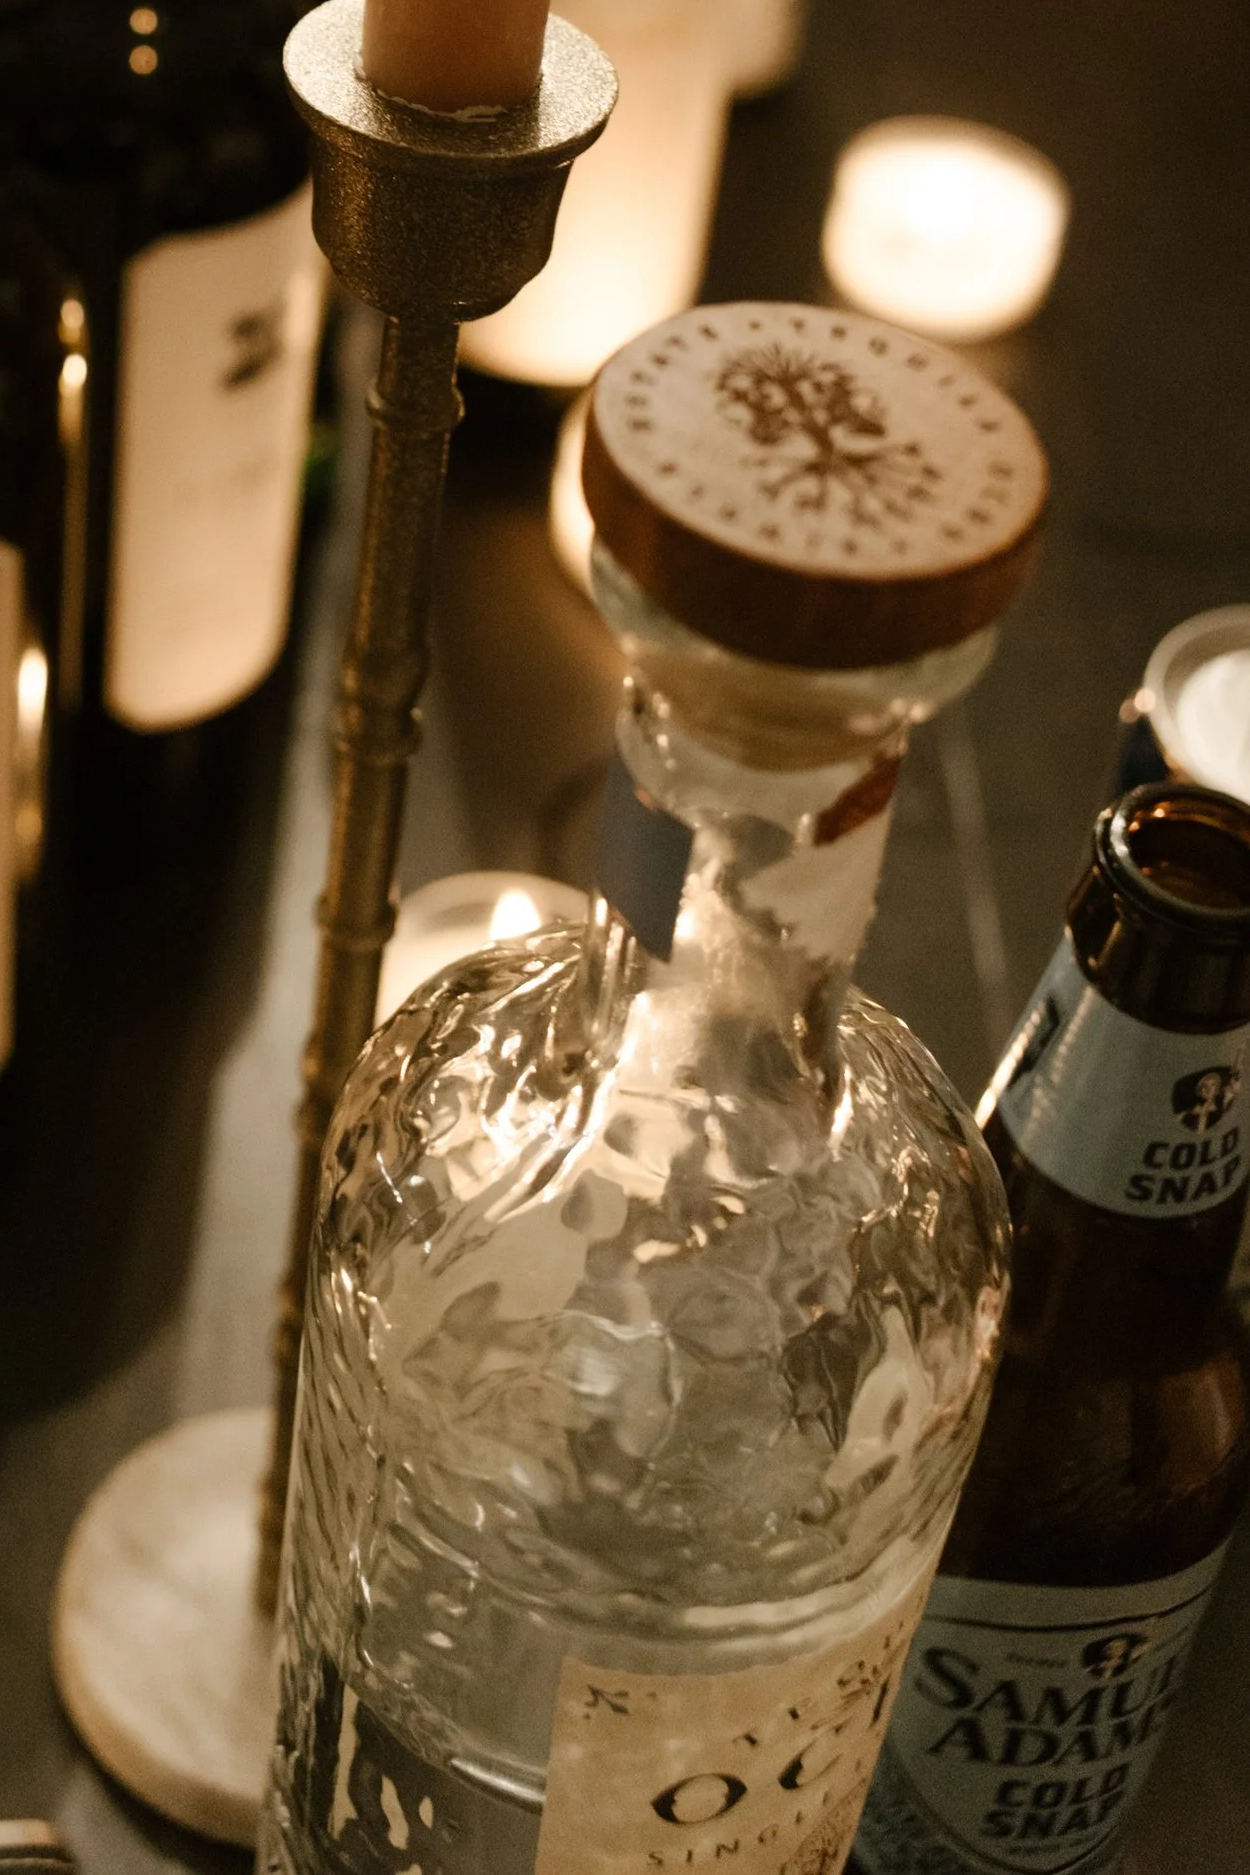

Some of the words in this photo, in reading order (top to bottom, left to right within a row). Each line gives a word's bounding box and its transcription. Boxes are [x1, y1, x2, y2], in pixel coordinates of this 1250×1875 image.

[1143, 1126, 1239, 1170] COLD
[1124, 1154, 1242, 1205] SNAP
[996, 1763, 1131, 1809] COLD
